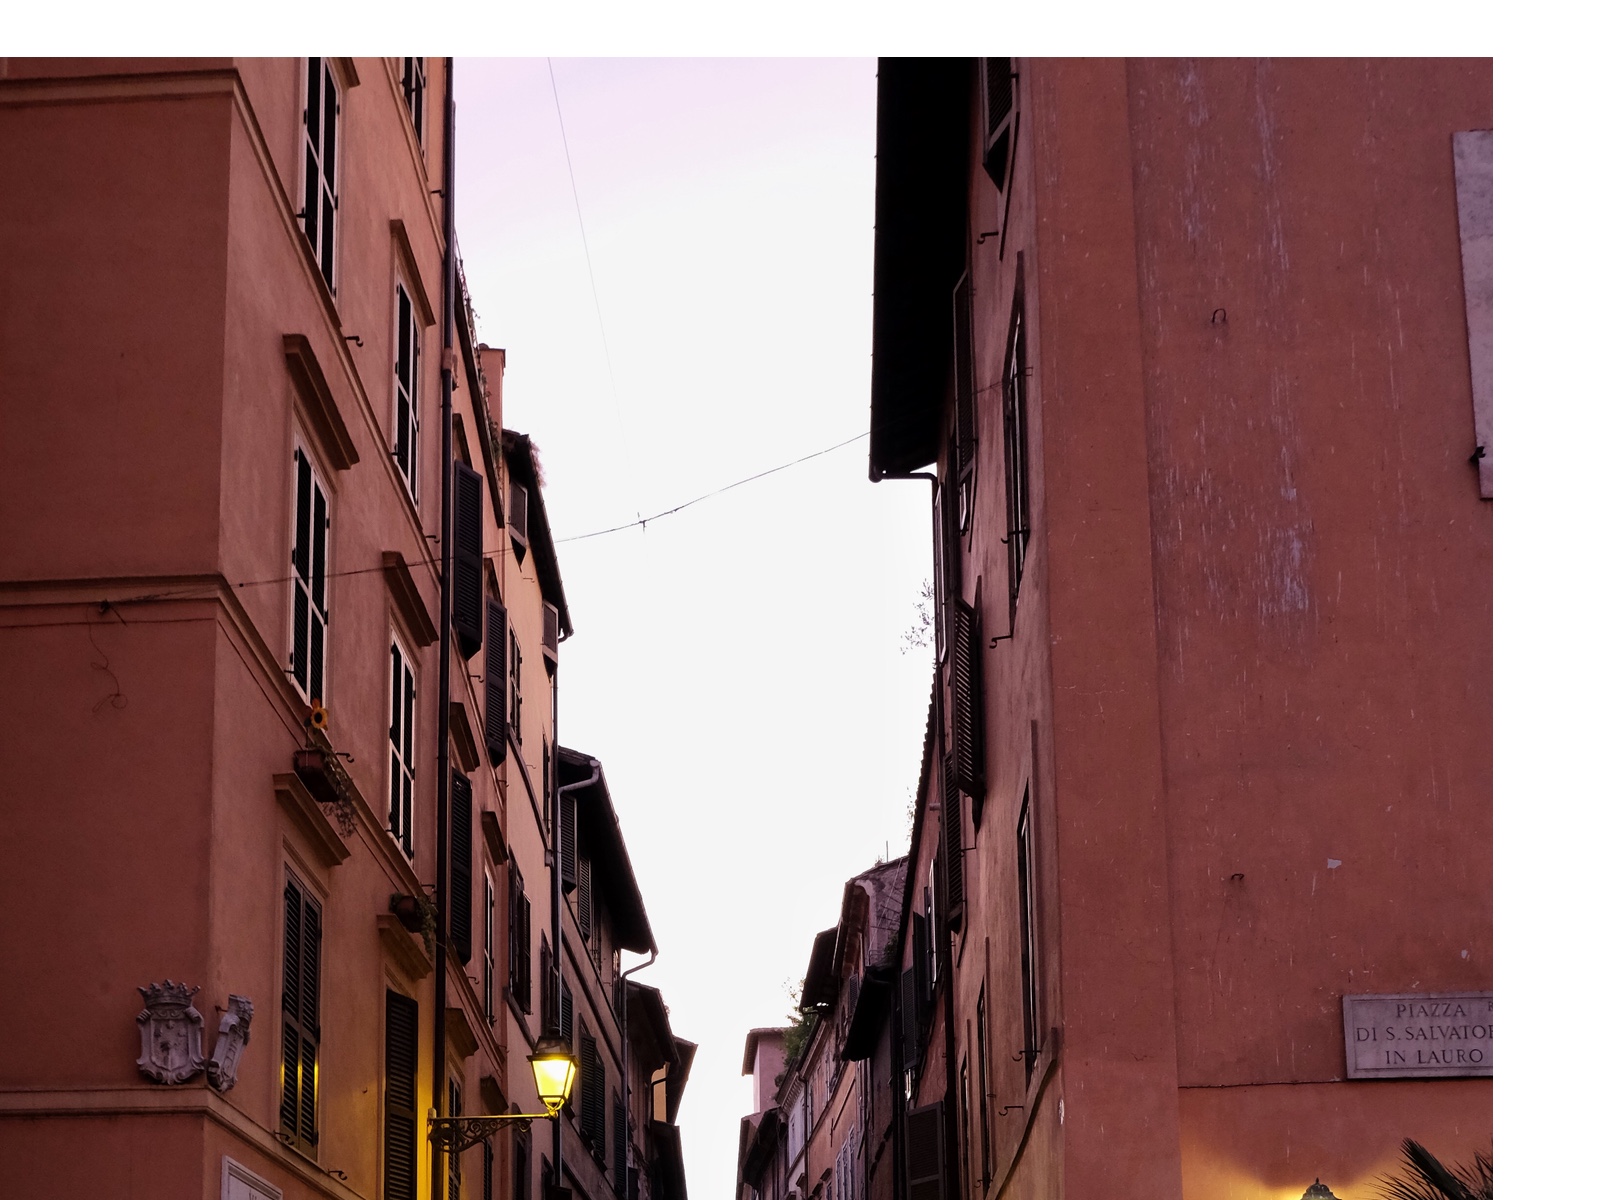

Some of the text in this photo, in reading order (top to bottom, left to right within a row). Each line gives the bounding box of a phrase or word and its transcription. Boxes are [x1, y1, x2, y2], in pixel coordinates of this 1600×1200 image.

[1396, 1002, 1467, 1018] PIAZZA
[1357, 1027, 1377, 1042] DI
[1386, 1048, 1483, 1065] IN LAURO
